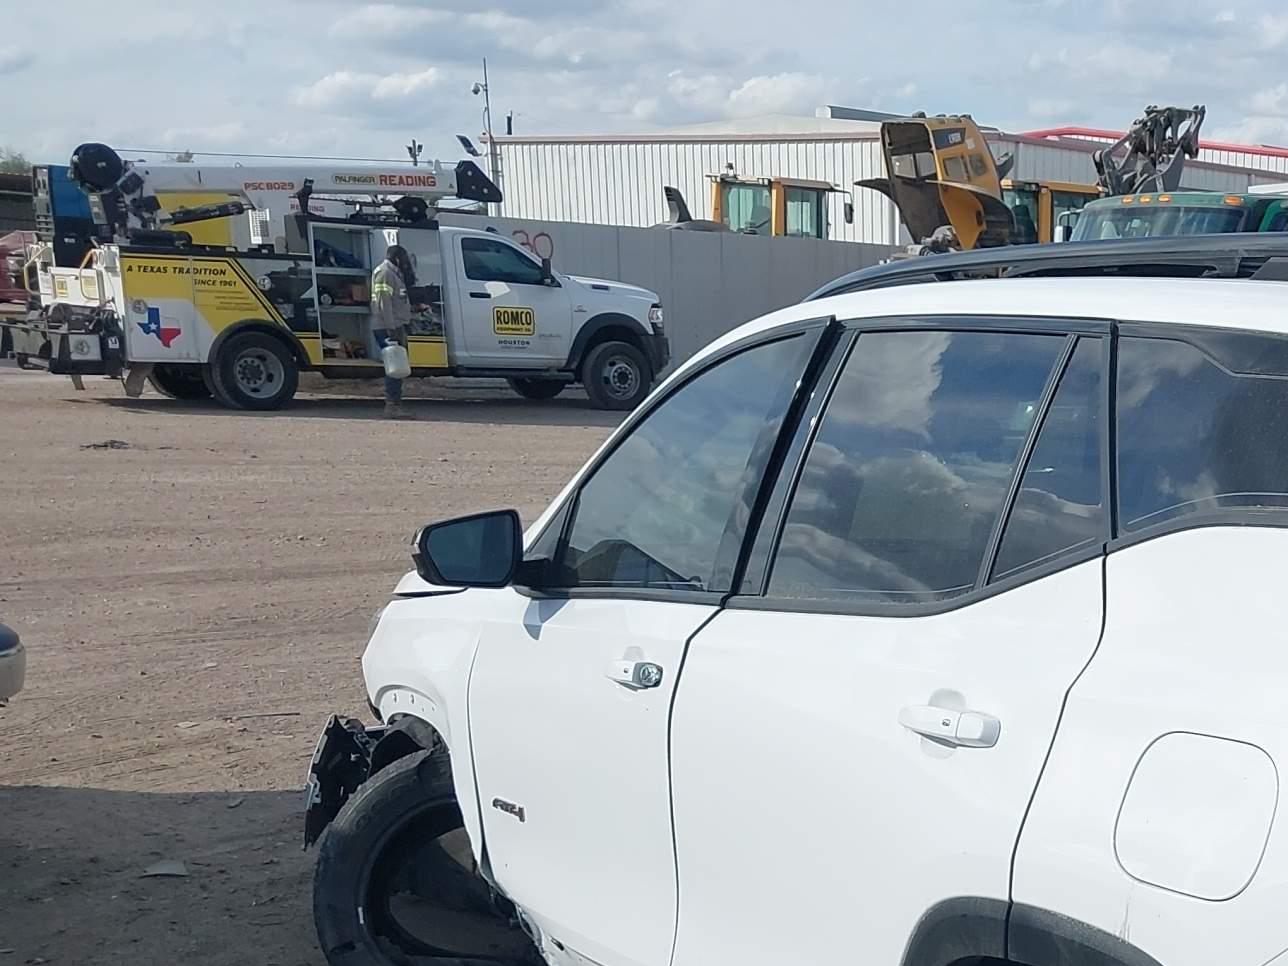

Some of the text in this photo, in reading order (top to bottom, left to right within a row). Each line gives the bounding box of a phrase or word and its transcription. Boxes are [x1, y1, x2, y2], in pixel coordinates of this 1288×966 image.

[379, 174, 437, 187] READING
[127, 265, 227, 276] A TEXAS TRADITION
[496, 310, 532, 326] ROMCO
